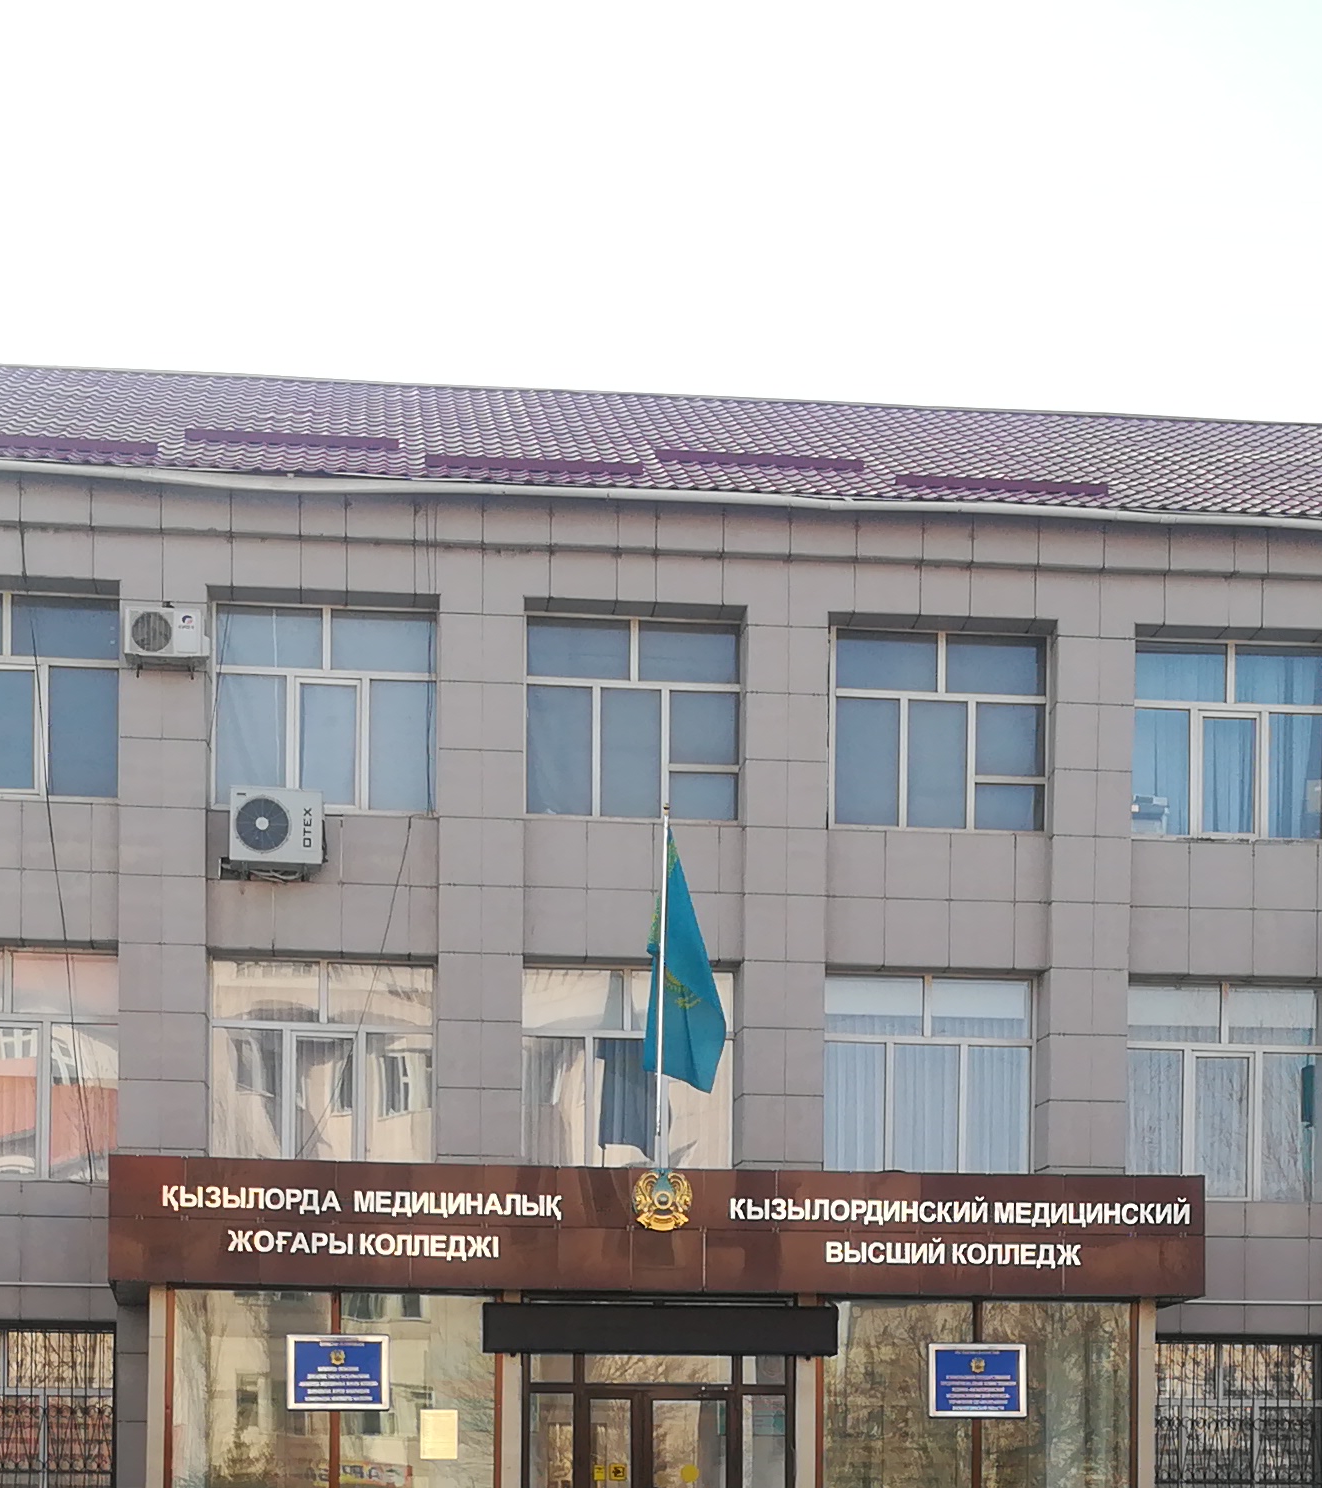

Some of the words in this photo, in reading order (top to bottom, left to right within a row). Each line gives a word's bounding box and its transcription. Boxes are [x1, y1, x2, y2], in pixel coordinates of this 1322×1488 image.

[162, 1184, 342, 1213] ҚЫЗЫЛОРДА
[353, 1190, 563, 1220] МЕДИЦИНАЛЫҚ
[729, 1195, 989, 1226] КЫЗЫЛОРДИНСКИЙ
[993, 1197, 1191, 1228] МЕДИЦИНСКИЙ
[227, 1229, 354, 1255] ЖОҒАРЫ
[359, 1232, 500, 1262] КОЛЛЕДЖІ
[825, 1236, 946, 1265] ВЫСШИЙ
[951, 1241, 1082, 1270] КОЛЛЕДЖ
